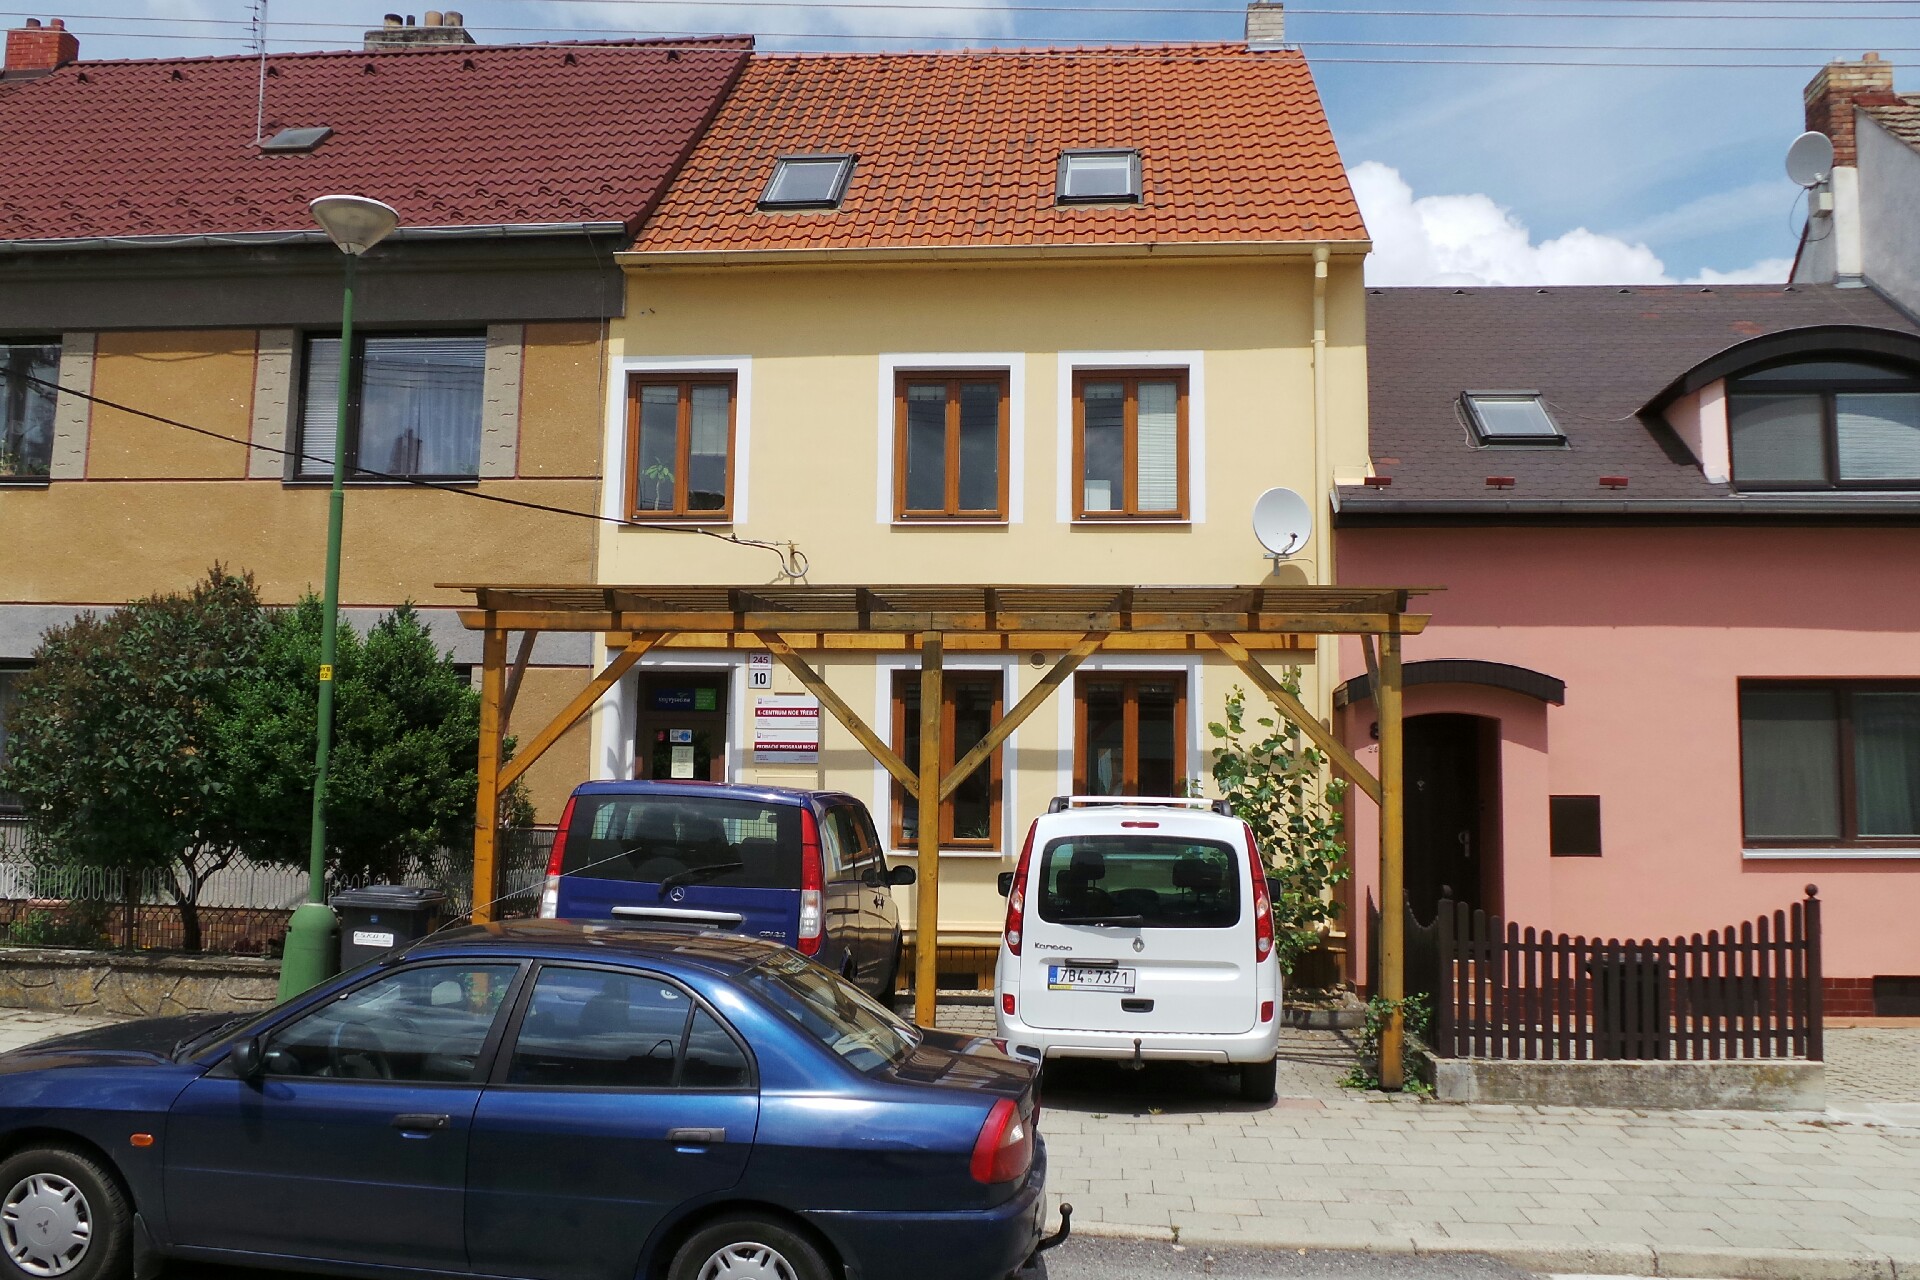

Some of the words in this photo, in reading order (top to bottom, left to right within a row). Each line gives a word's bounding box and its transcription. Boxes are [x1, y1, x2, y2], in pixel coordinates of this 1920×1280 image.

[752, 656, 769, 664] 245
[754, 672, 766, 685] 10
[1034, 942, 1073, 951] Kangoo
[1060, 969, 1084, 983] 7B4
[1095, 970, 1129, 985] 7371
